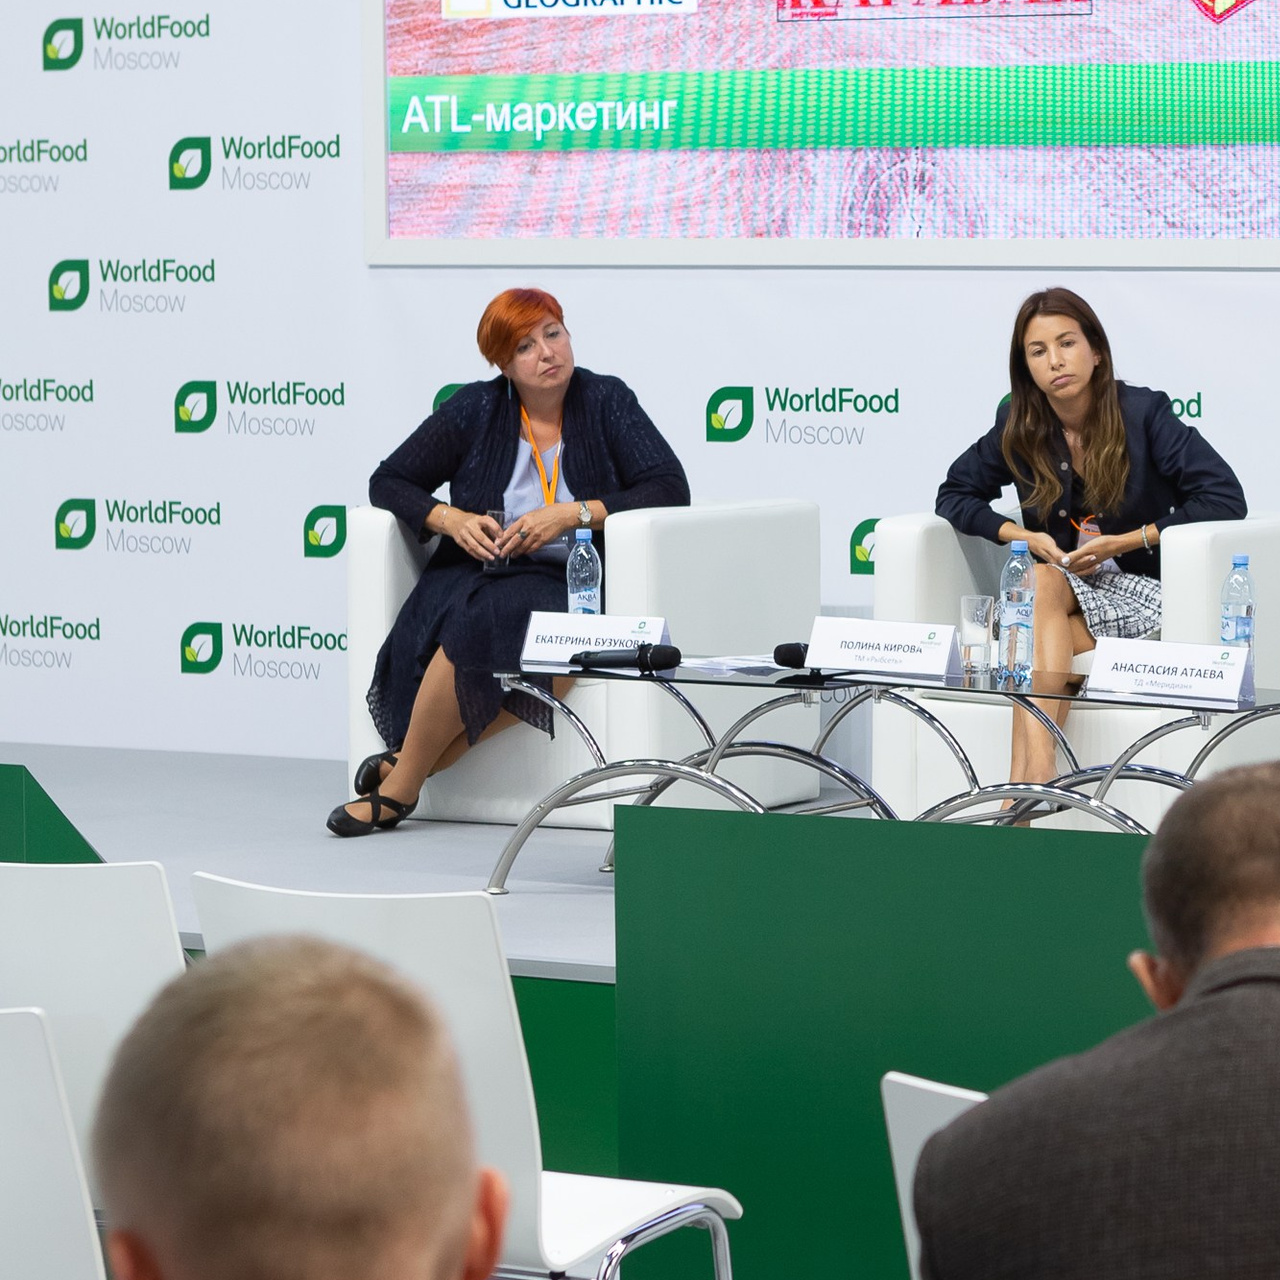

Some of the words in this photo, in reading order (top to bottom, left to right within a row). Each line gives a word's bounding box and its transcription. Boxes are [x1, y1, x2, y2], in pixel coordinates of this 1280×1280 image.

[94, 14, 209, 40] WorldFood
[94, 46, 180, 71] Moscow
[401, 94, 679, 141] ATL-маркетинг
[0, 139, 87, 163] orldFood
[222, 134, 340, 159] WorldFood
[222, 166, 310, 190] Moscow
[99, 259, 215, 282] WorldFood
[100, 288, 186, 313] Moscow
[0, 378, 93, 402] orldFood
[227, 381, 344, 406] WorldFood
[765, 387, 898, 413] WorldFood
[2, 413, 65, 431] oscow
[228, 410, 315, 436] Moscow
[766, 418, 864, 445] Moscow
[106, 500, 220, 525] WorldFood
[106, 528, 191, 554] Moscow
[535, 634, 592, 647] ЕКАТЕРИНА
[594, 637, 646, 649] БУЗУКОВА
[840, 640, 881, 652] ПОЛИНА
[883, 642, 923, 654] КИРОВА
[234, 653, 320, 679] Moscow
[1110, 662, 1179, 677] АНАСТАСИЯ
[1180, 667, 1225, 680] АТАЕВА
